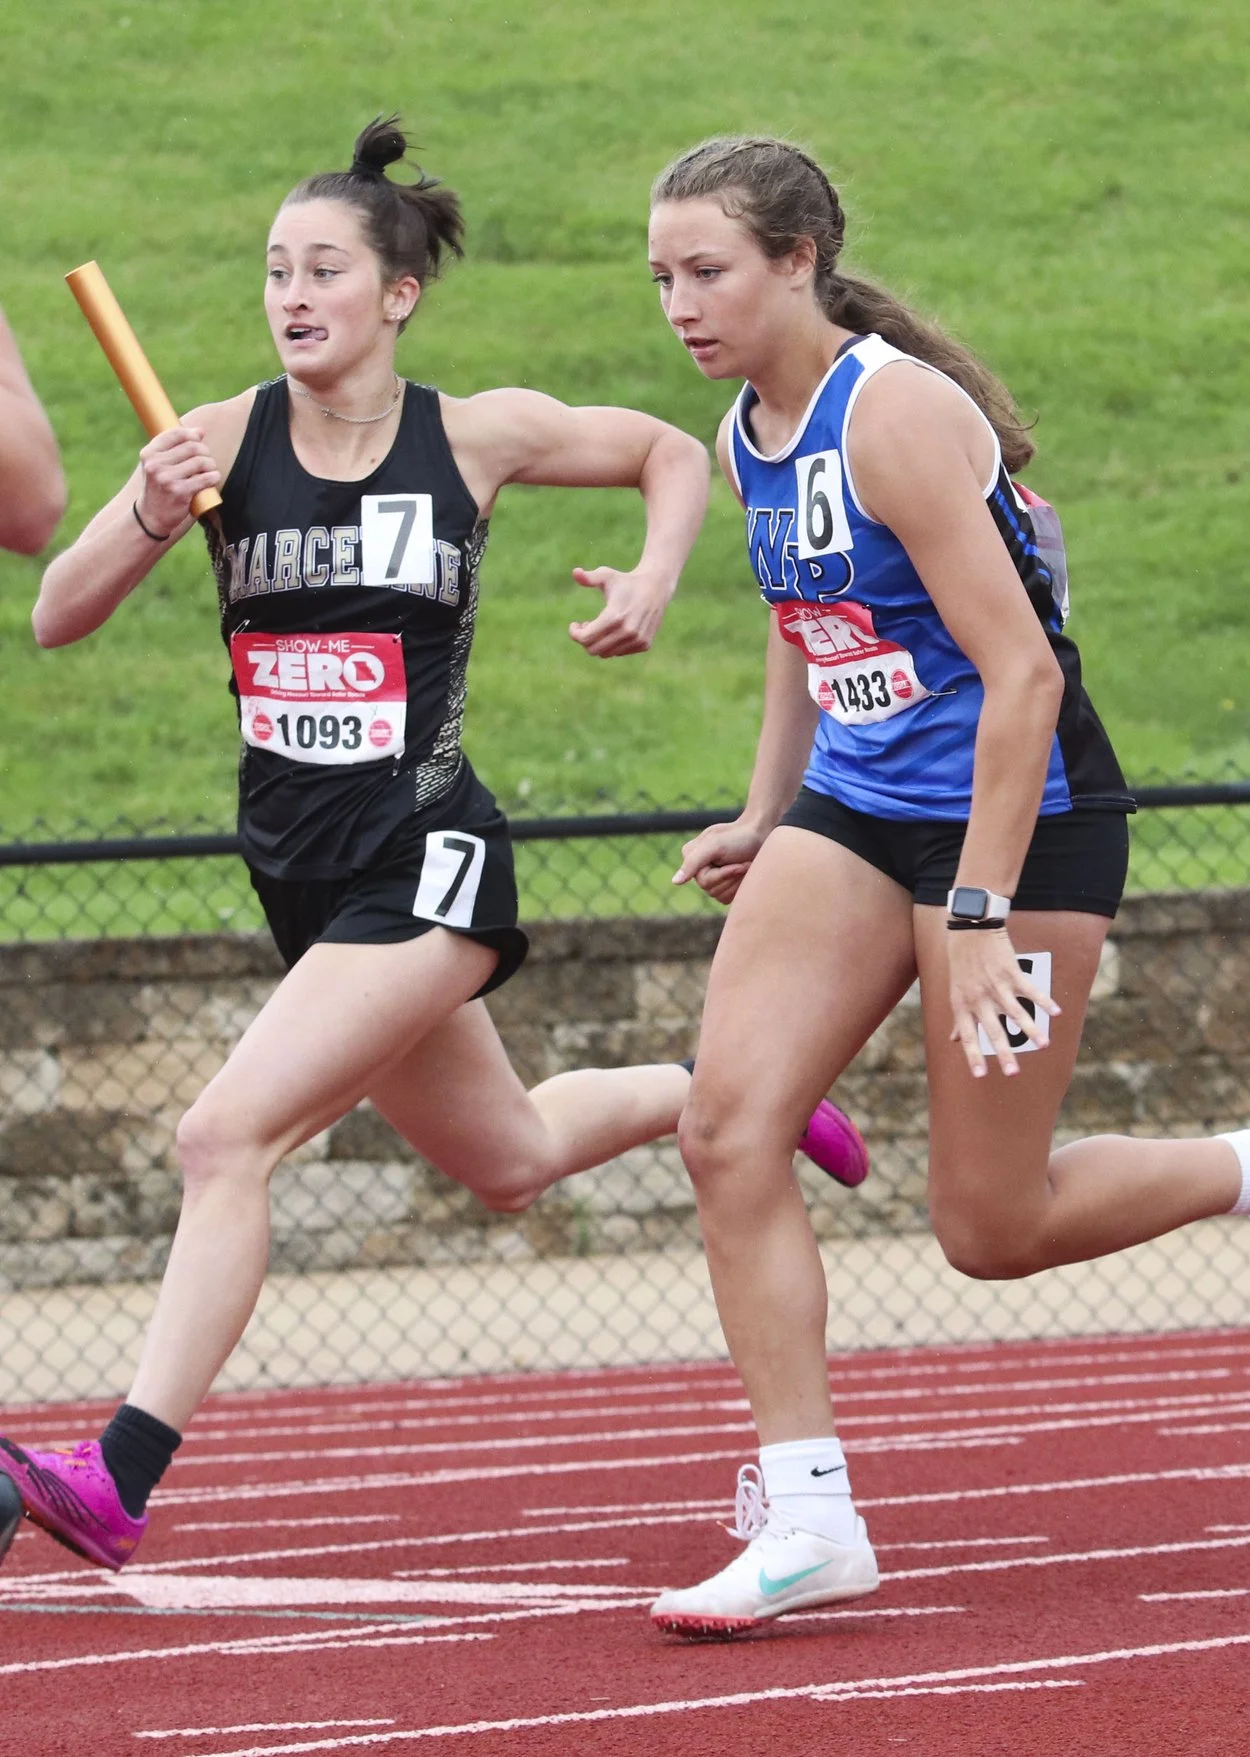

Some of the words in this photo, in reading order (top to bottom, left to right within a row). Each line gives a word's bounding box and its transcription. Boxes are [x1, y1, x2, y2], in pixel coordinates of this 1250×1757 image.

[806, 458, 833, 550] 6
[224, 526, 462, 607] MARCEE
[378, 500, 417, 579] 7
[248, 651, 385, 692] ZERO
[276, 639, 350, 653] SHOW-ME
[832, 670, 891, 713] 1433
[277, 714, 362, 750] 1093
[434, 836, 476, 917] 7
